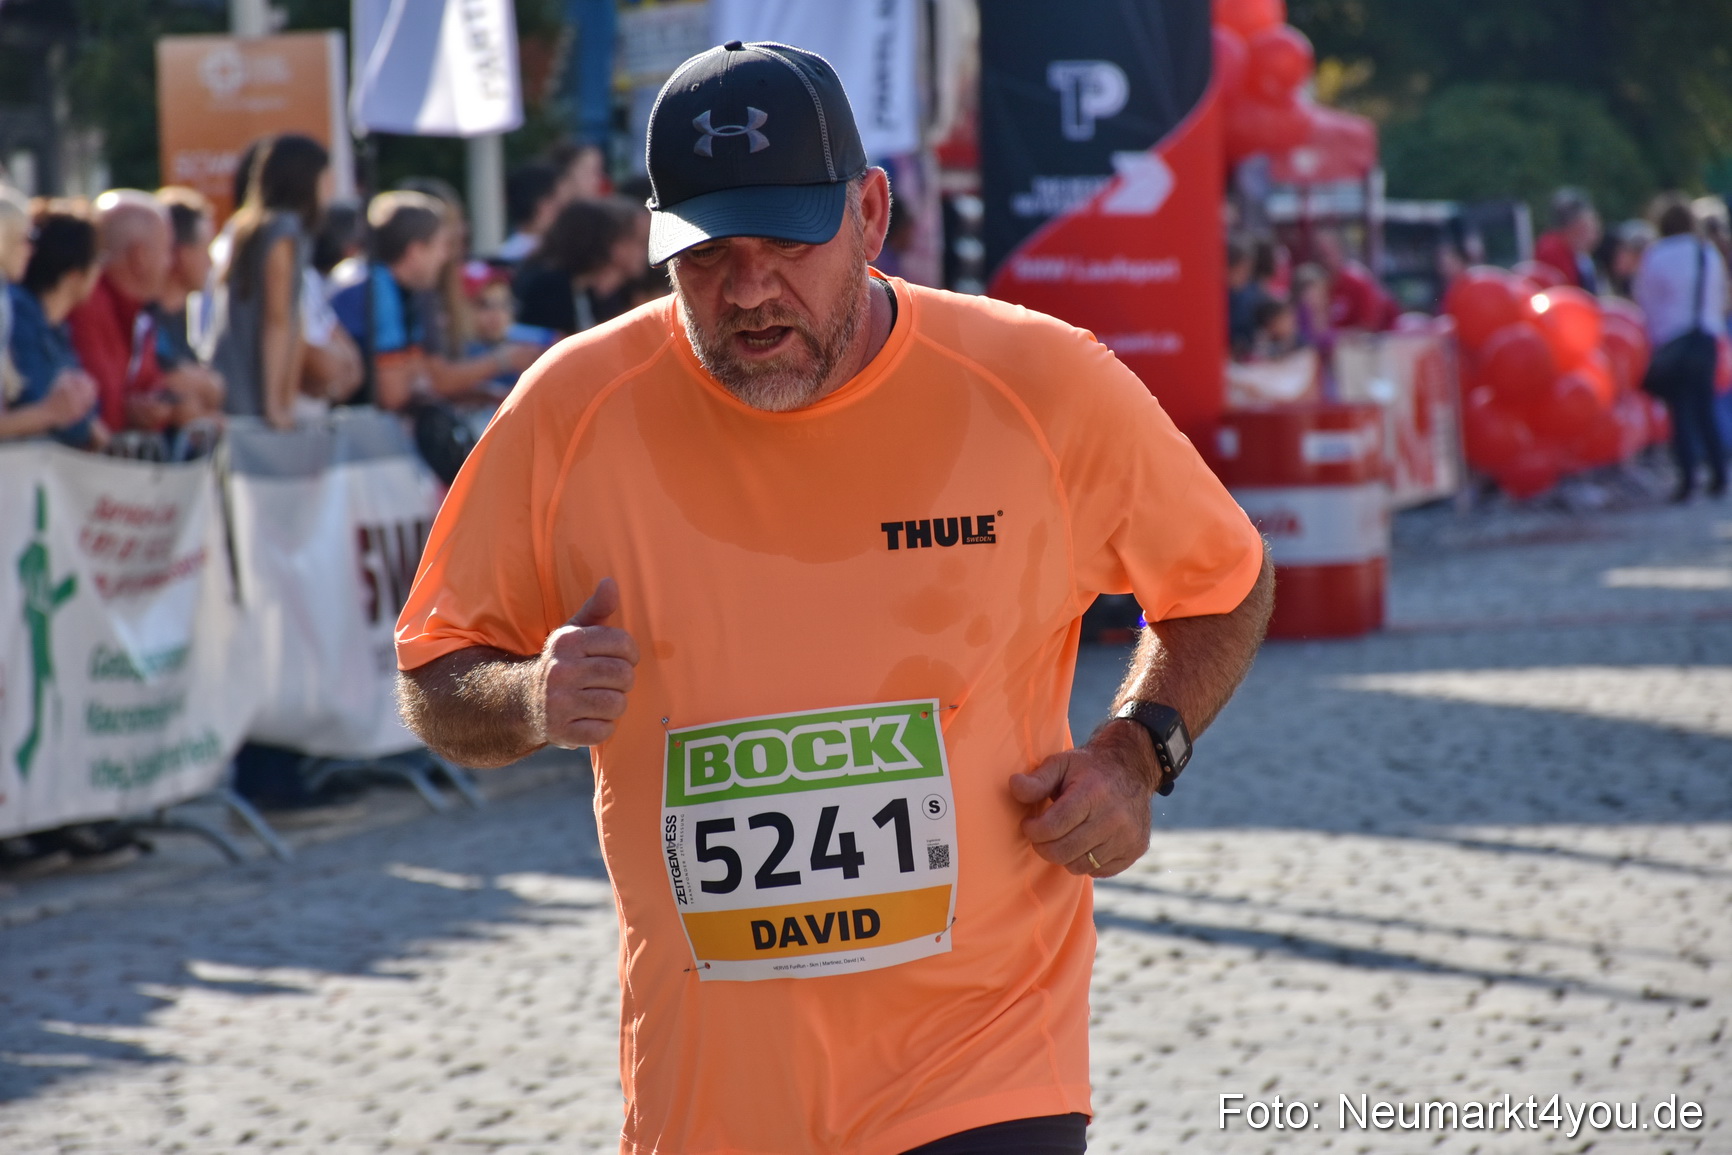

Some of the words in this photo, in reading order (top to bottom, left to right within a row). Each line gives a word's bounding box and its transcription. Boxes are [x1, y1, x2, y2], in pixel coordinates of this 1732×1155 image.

[881, 514, 997, 550] THULE
[687, 718, 914, 791] BOCK
[928, 799, 941, 814] S
[695, 797, 916, 895] 5241
[750, 907, 882, 951] DAVID
